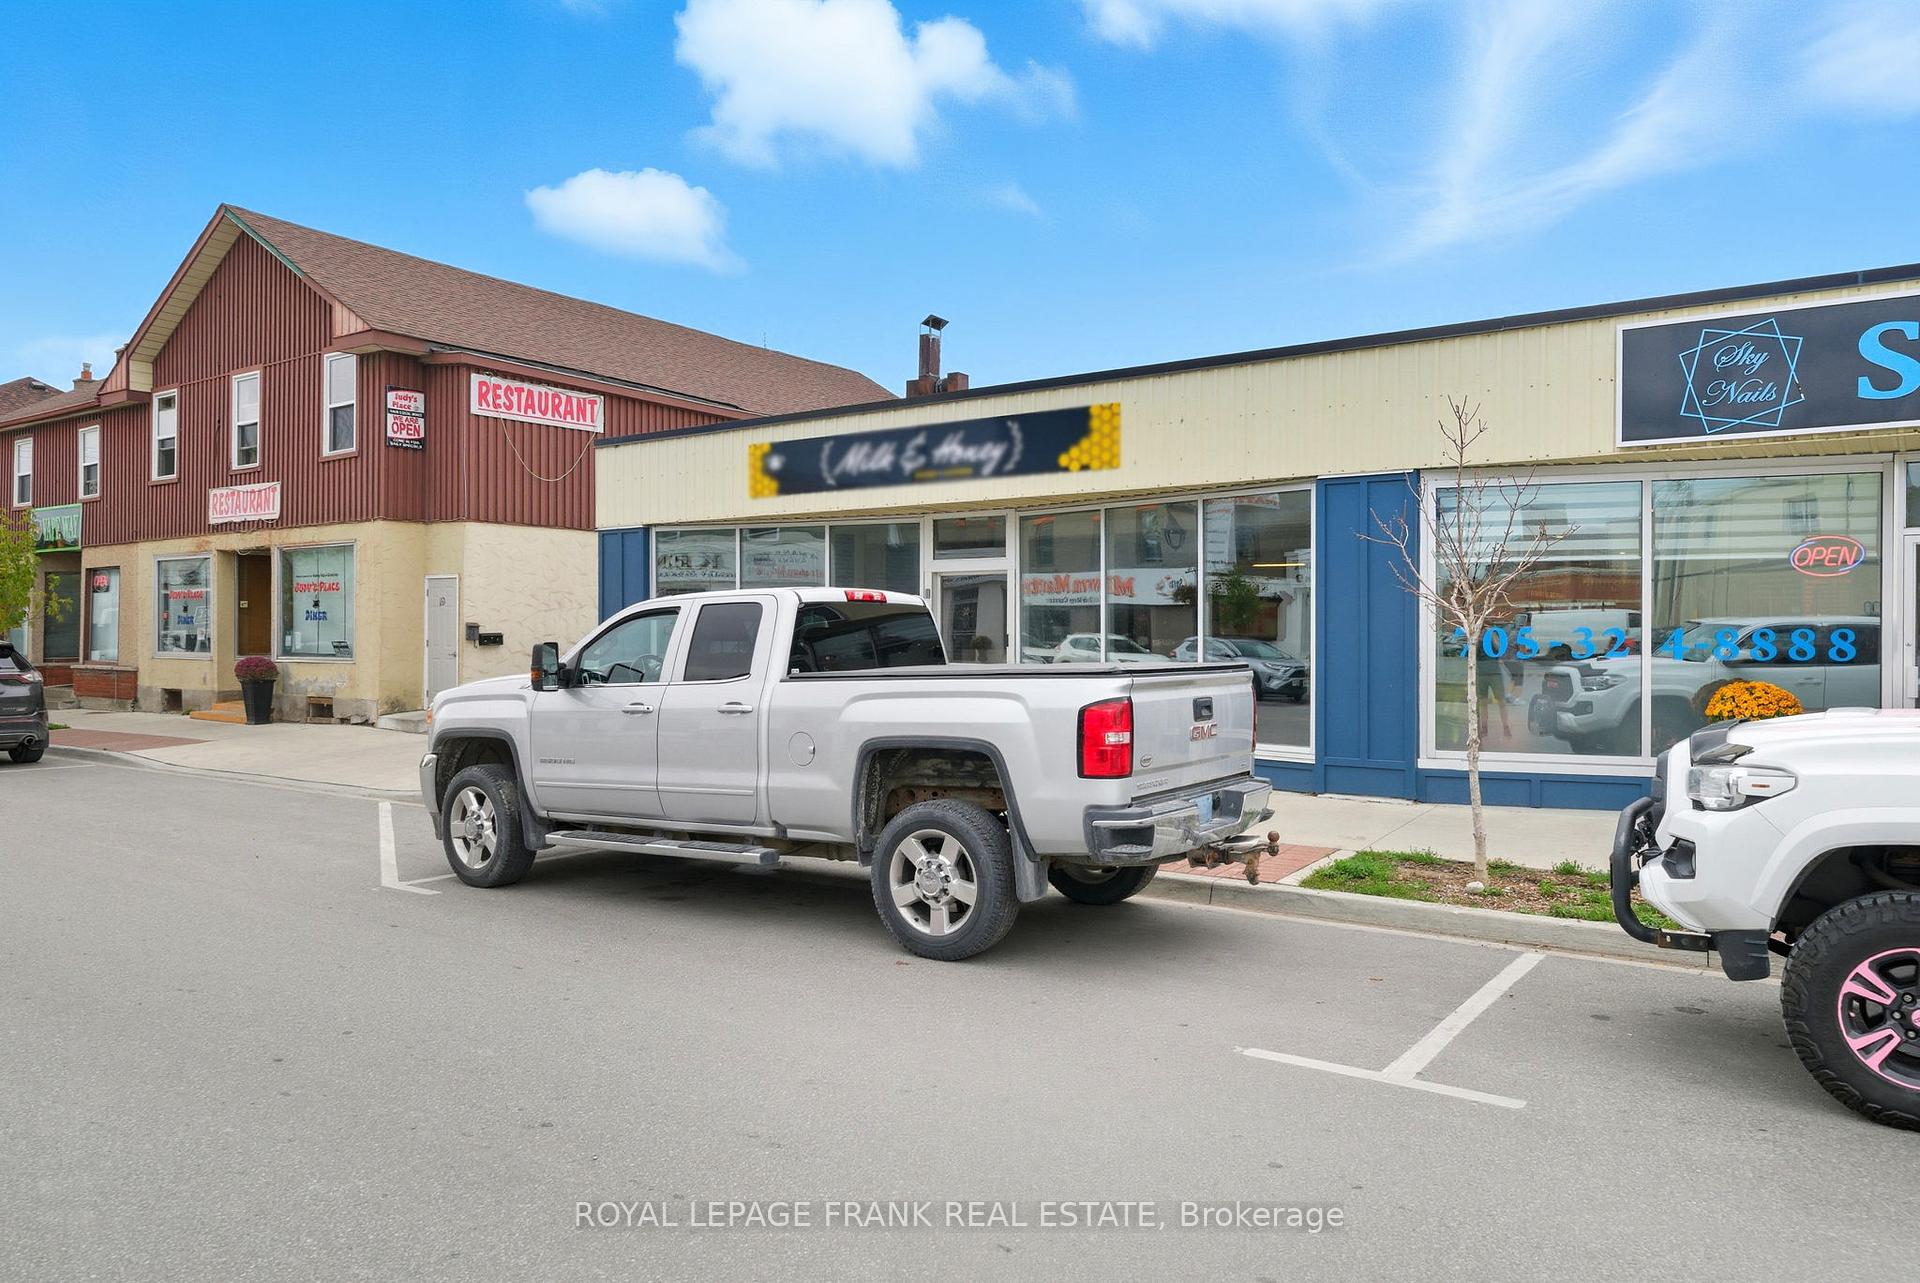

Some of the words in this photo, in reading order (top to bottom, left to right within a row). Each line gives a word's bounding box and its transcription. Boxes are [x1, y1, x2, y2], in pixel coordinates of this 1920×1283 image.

[1713, 341, 1770, 375] Sky
[477, 380, 598, 424] RESTAURANT
[1702, 378, 1778, 406] Nails
[392, 401, 411, 410] Place
[391, 422, 420, 437] OPEN
[212, 486, 277, 516] RESTAURANT
[1794, 544, 1858, 567] OPEN
[1189, 723, 1218, 742] GMC
